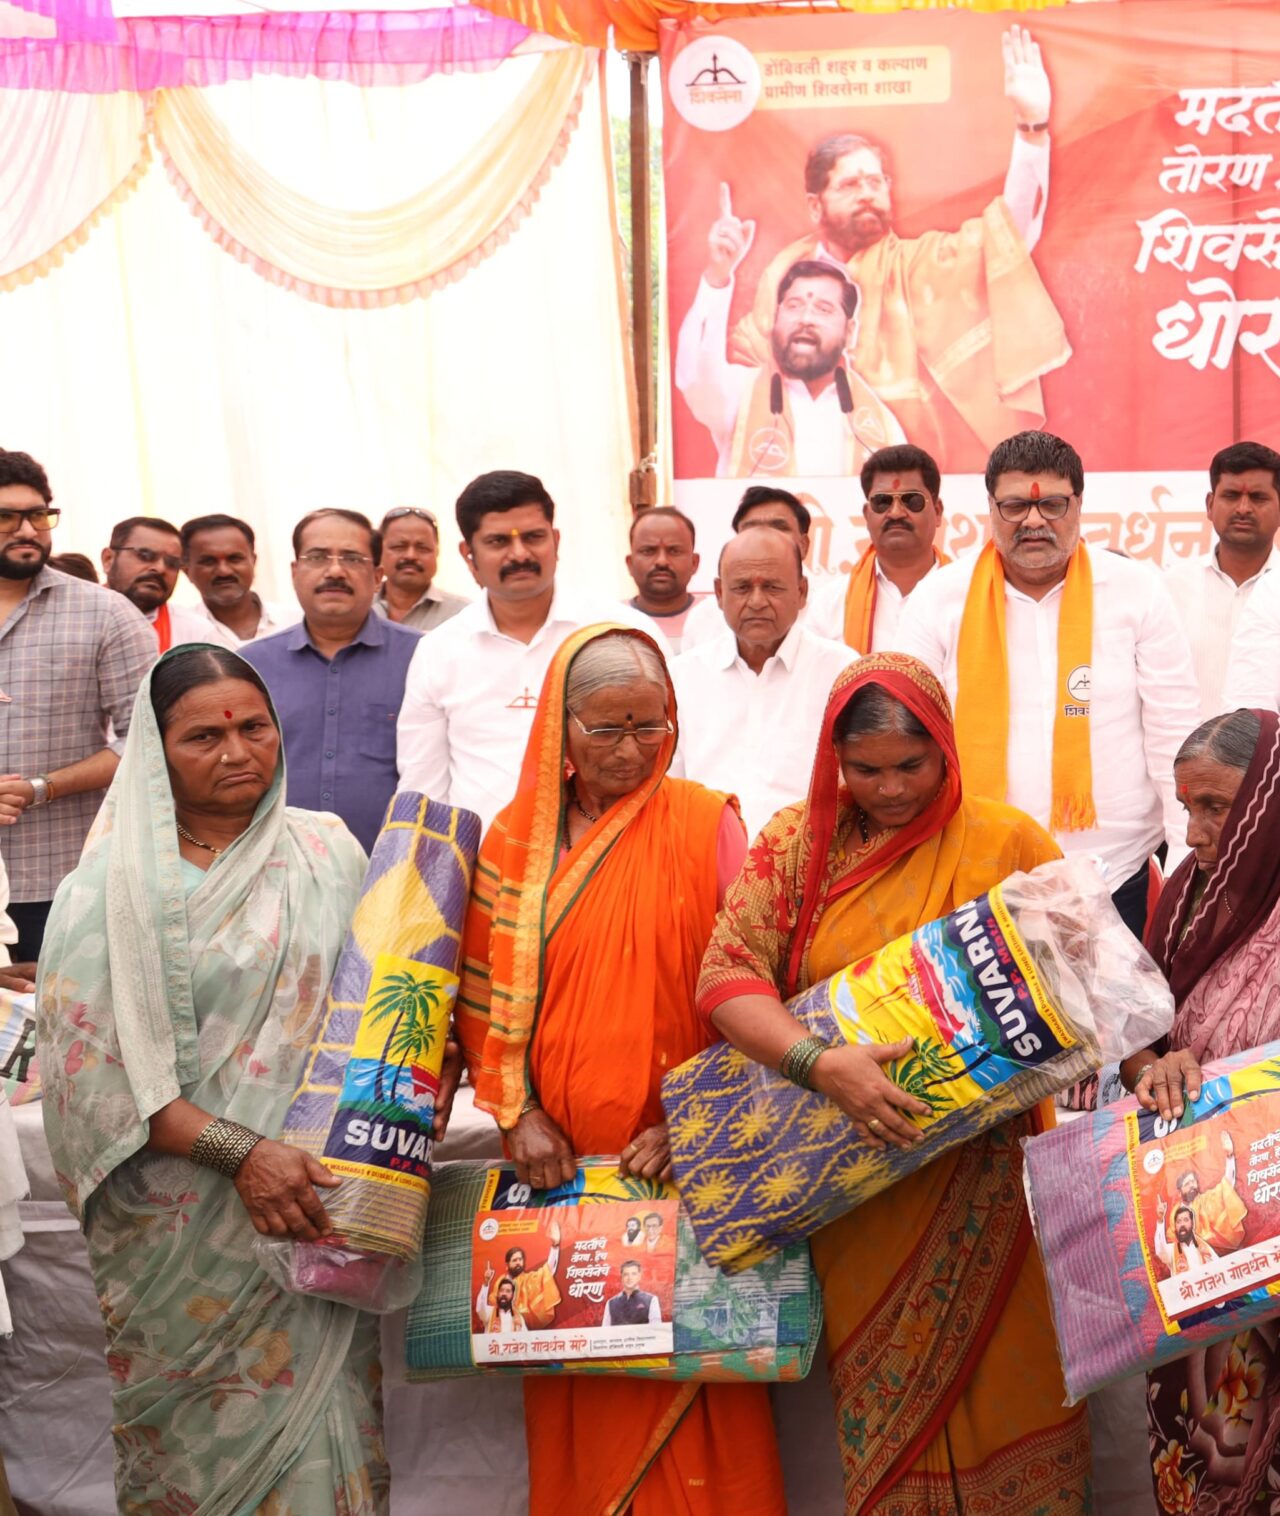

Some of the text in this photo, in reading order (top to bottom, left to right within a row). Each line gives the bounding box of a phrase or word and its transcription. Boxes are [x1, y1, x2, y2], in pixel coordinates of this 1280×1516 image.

[828, 59, 857, 75] शहर
[878, 56, 928, 72] कल्याण
[875, 80, 912, 95] शाखा
[568, 1279, 606, 1303] धोरण
